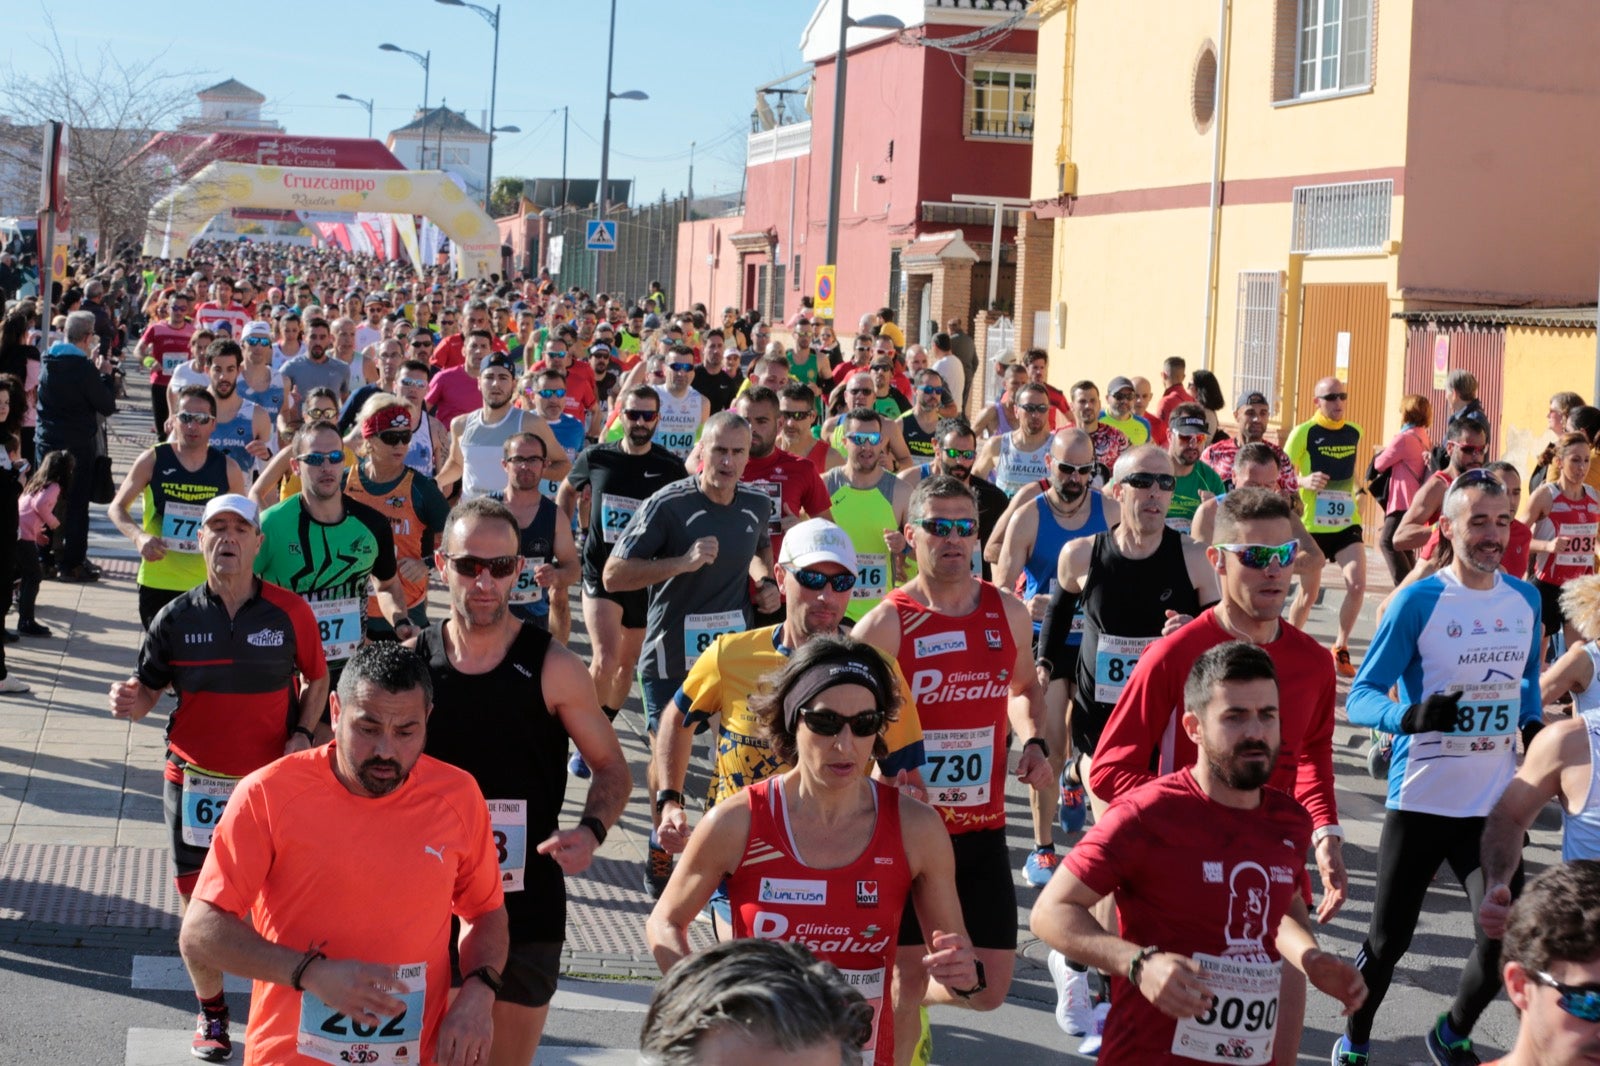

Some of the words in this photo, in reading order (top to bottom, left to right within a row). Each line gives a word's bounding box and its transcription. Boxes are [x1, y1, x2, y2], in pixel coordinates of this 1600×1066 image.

[281, 143, 336, 155] Diputación
[294, 156, 336, 167] Granada
[283, 172, 375, 193] Cruzcampo
[222, 439, 245, 447] SUMA
[661, 434, 693, 447] 1040
[161, 482, 219, 492] ATLETISMO
[1327, 502, 1345, 516] 39
[173, 518, 201, 537] 77
[1458, 651, 1525, 665] MARACENA
[948, 671, 990, 683] Clínicas
[1458, 704, 1509, 733] 875
[950, 731, 969, 739] PREMIO
[927, 753, 982, 782] 730
[489, 803, 497, 812] DE
[499, 803, 520, 812] FONDO
[796, 923, 850, 936] Clínicas
[401, 966, 422, 978] FONDO
[851, 974, 861, 985] DE
[861, 972, 880, 984] FONDO
